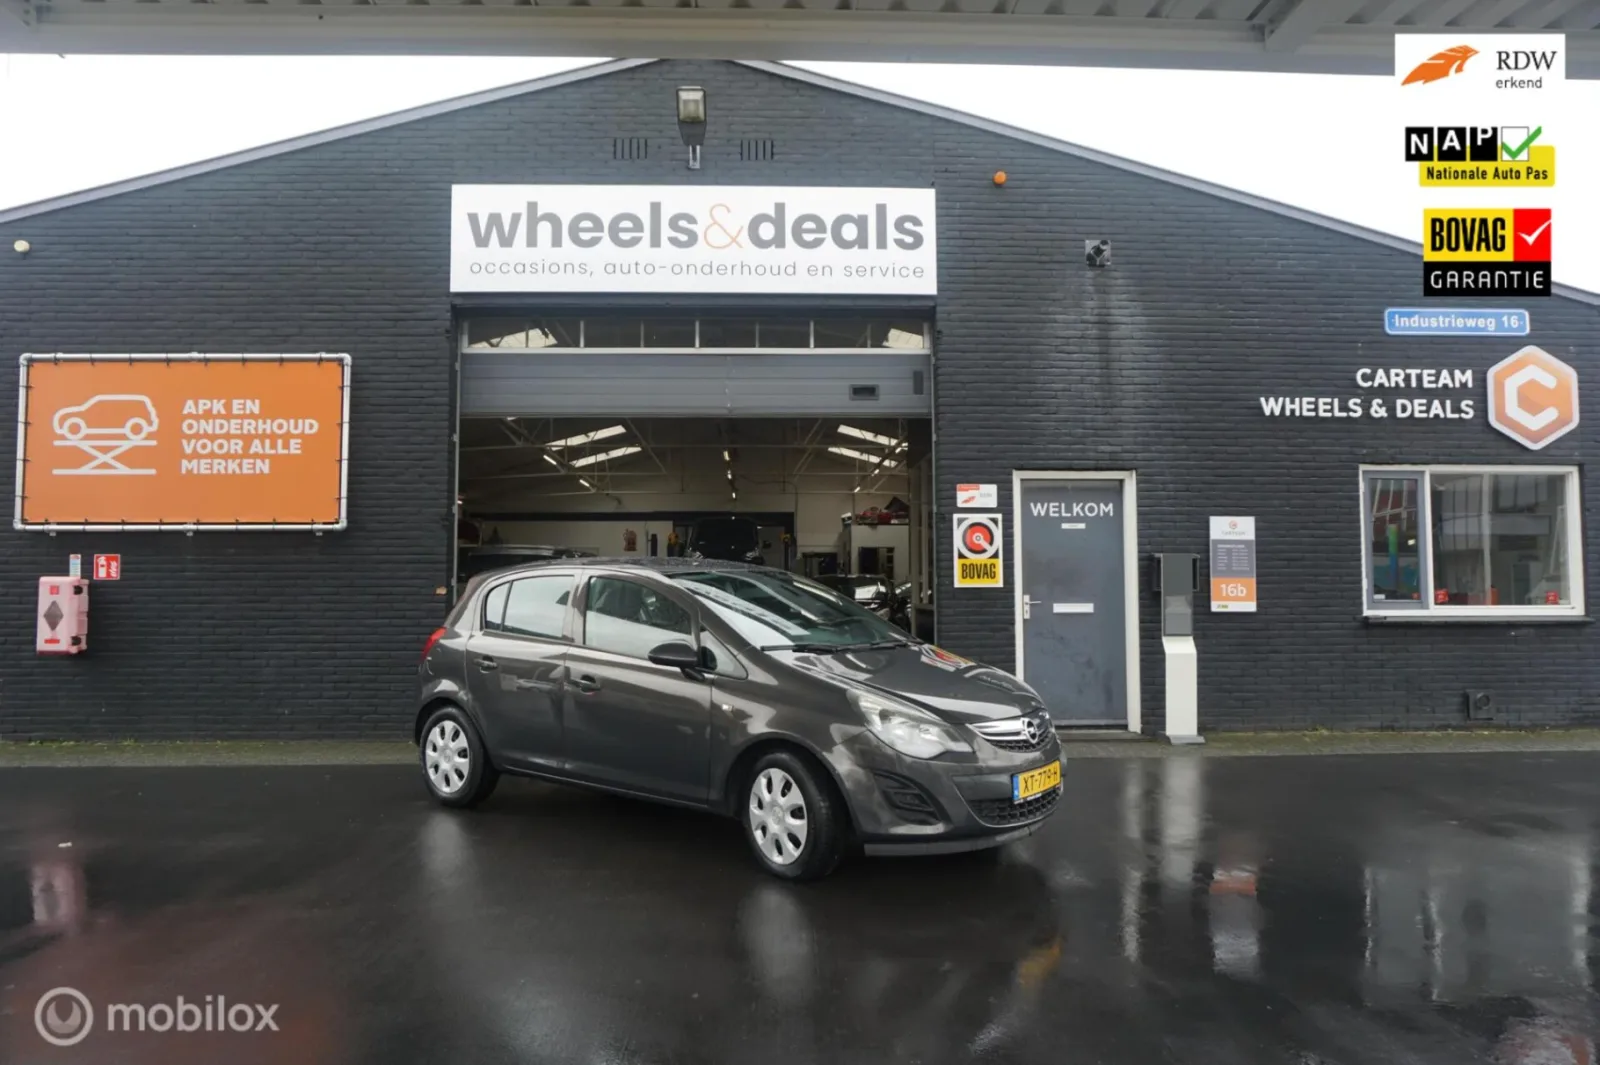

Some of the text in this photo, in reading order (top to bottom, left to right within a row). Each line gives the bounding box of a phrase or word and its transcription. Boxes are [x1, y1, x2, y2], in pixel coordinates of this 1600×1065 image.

[470, 259, 925, 278] occasions, auto-onderhoud en service
[1394, 314, 1520, 331] Industrieweg 16
[1356, 368, 1473, 388] CARTEAM
[182, 399, 260, 415] APK EN
[1260, 397, 1475, 419] WHEELS & DEALS
[181, 419, 319, 434] ONDERHOUD
[181, 439, 302, 454] VOOR ALLE
[181, 459, 270, 474] MERKEN
[1030, 502, 1114, 517] WELKOM
[961, 563, 997, 580] BOVAG
[1220, 583, 1247, 597] 16b
